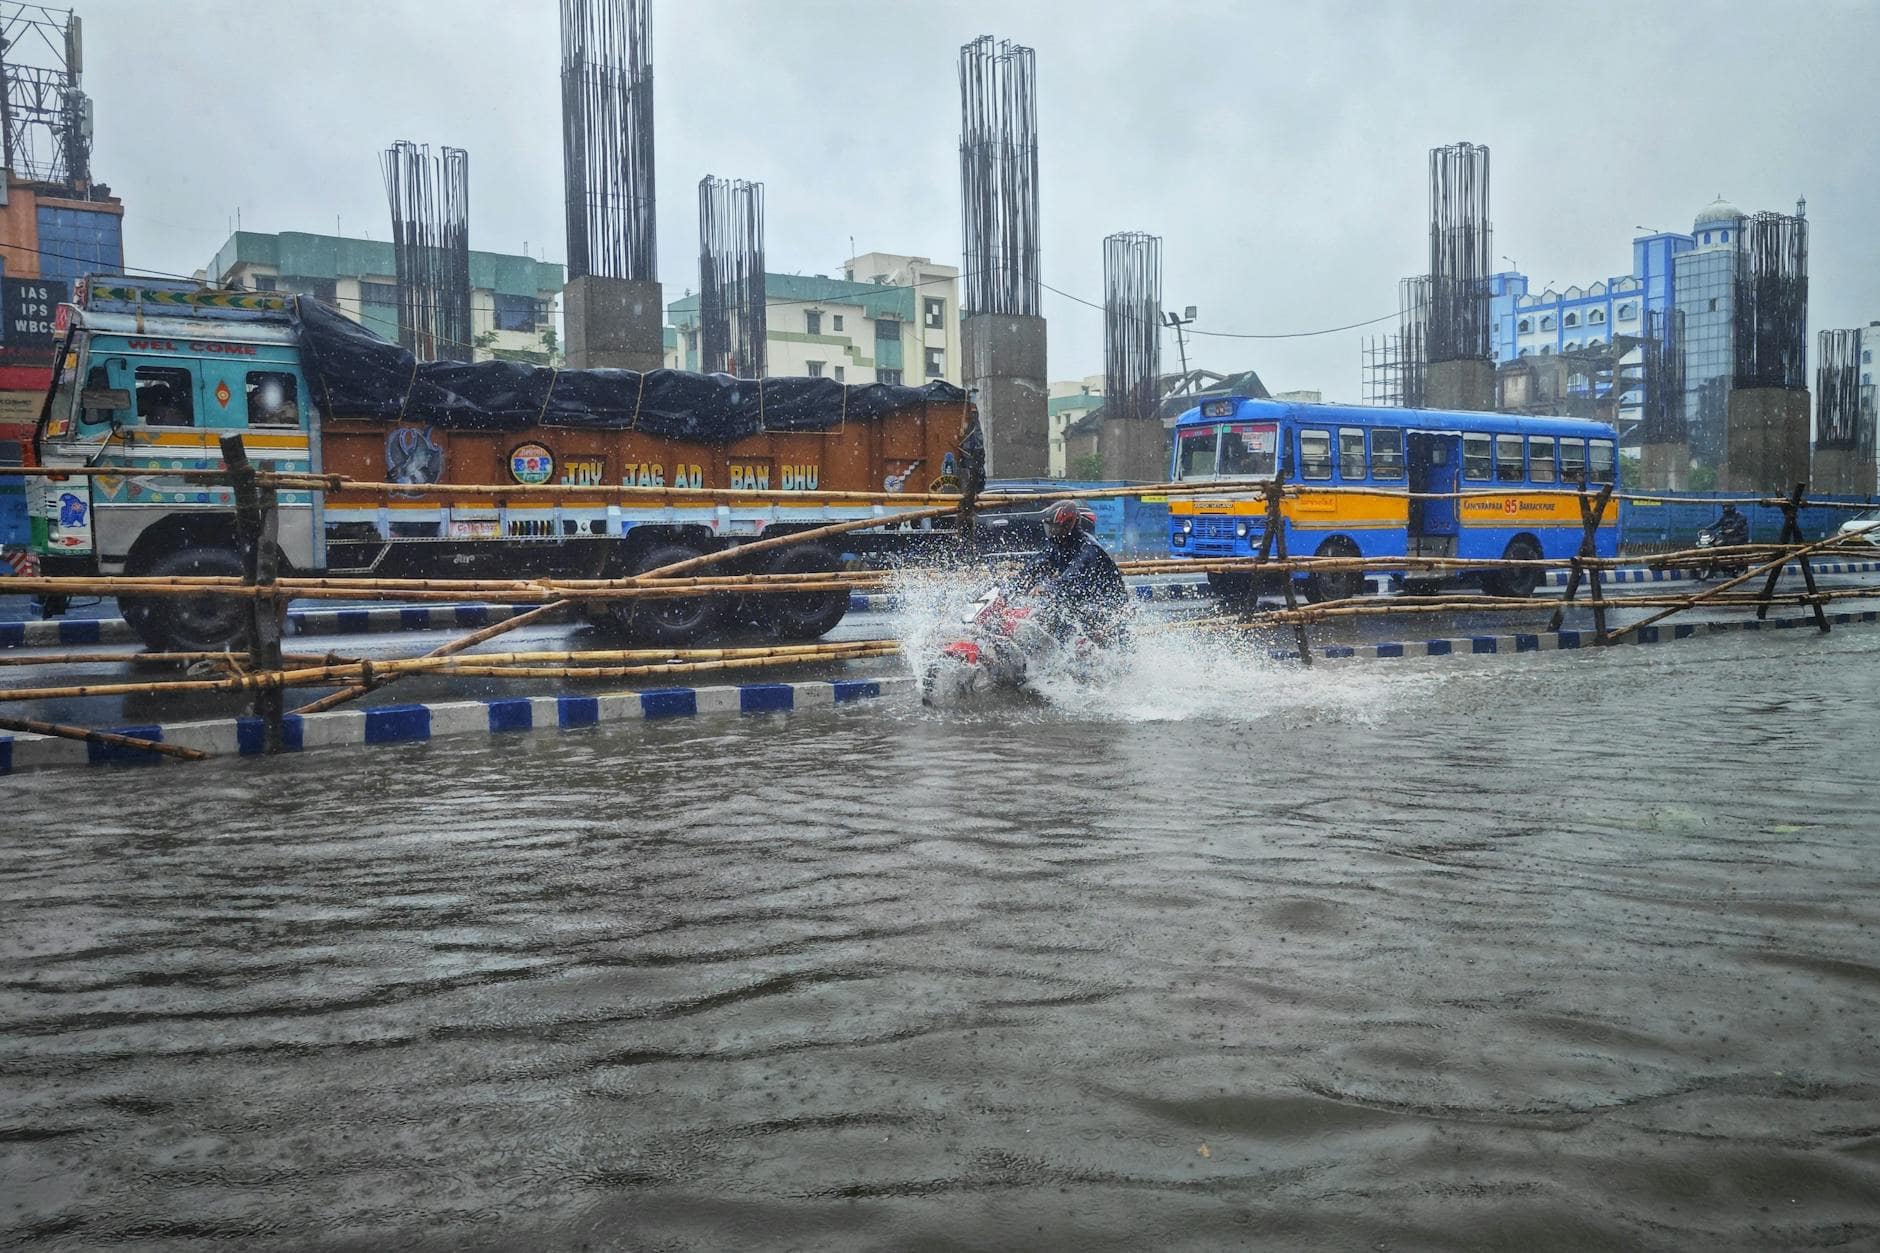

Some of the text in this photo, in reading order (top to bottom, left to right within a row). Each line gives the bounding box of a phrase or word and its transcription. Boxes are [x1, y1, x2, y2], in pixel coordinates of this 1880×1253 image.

[21, 286, 48, 299] IAS
[22, 303, 48, 316] IPS
[15, 319, 56, 333] WBCS
[128, 339, 257, 355] WEL COME
[561, 462, 819, 490] JOY JAG AD BAN DHU
